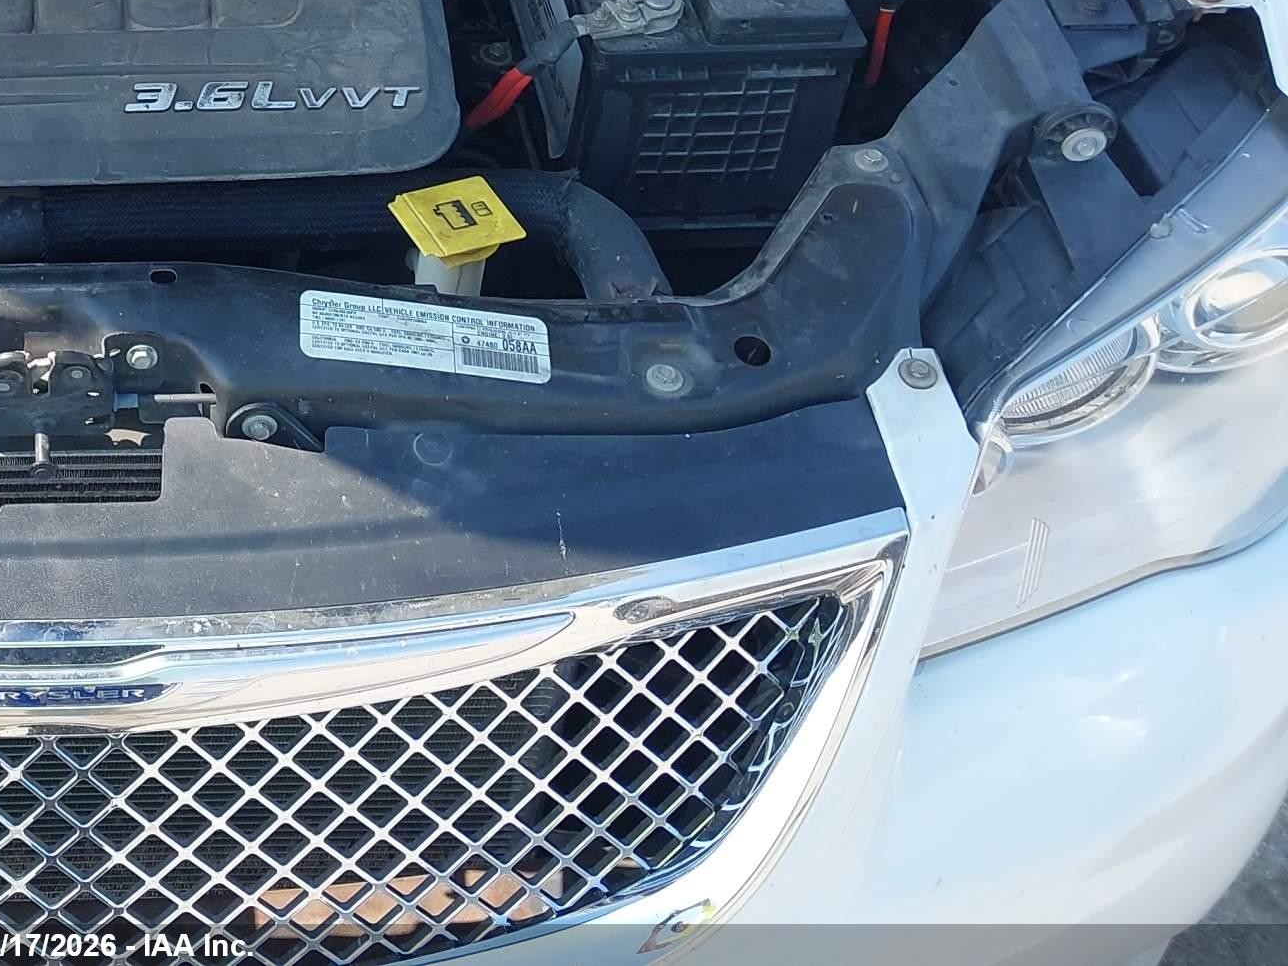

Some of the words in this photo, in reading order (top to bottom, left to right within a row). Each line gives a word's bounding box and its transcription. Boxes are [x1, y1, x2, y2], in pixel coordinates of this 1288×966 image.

[312, 298, 341, 308] Chrysler
[344, 302, 366, 312] Group
[368, 305, 381, 313] LLC
[385, 307, 413, 317] VEHICLE
[415, 310, 450, 321] EMISSION
[452, 315, 484, 326] CONTROL
[487, 319, 536, 332] INFORMATION
[502, 338, 538, 354] 058AA
